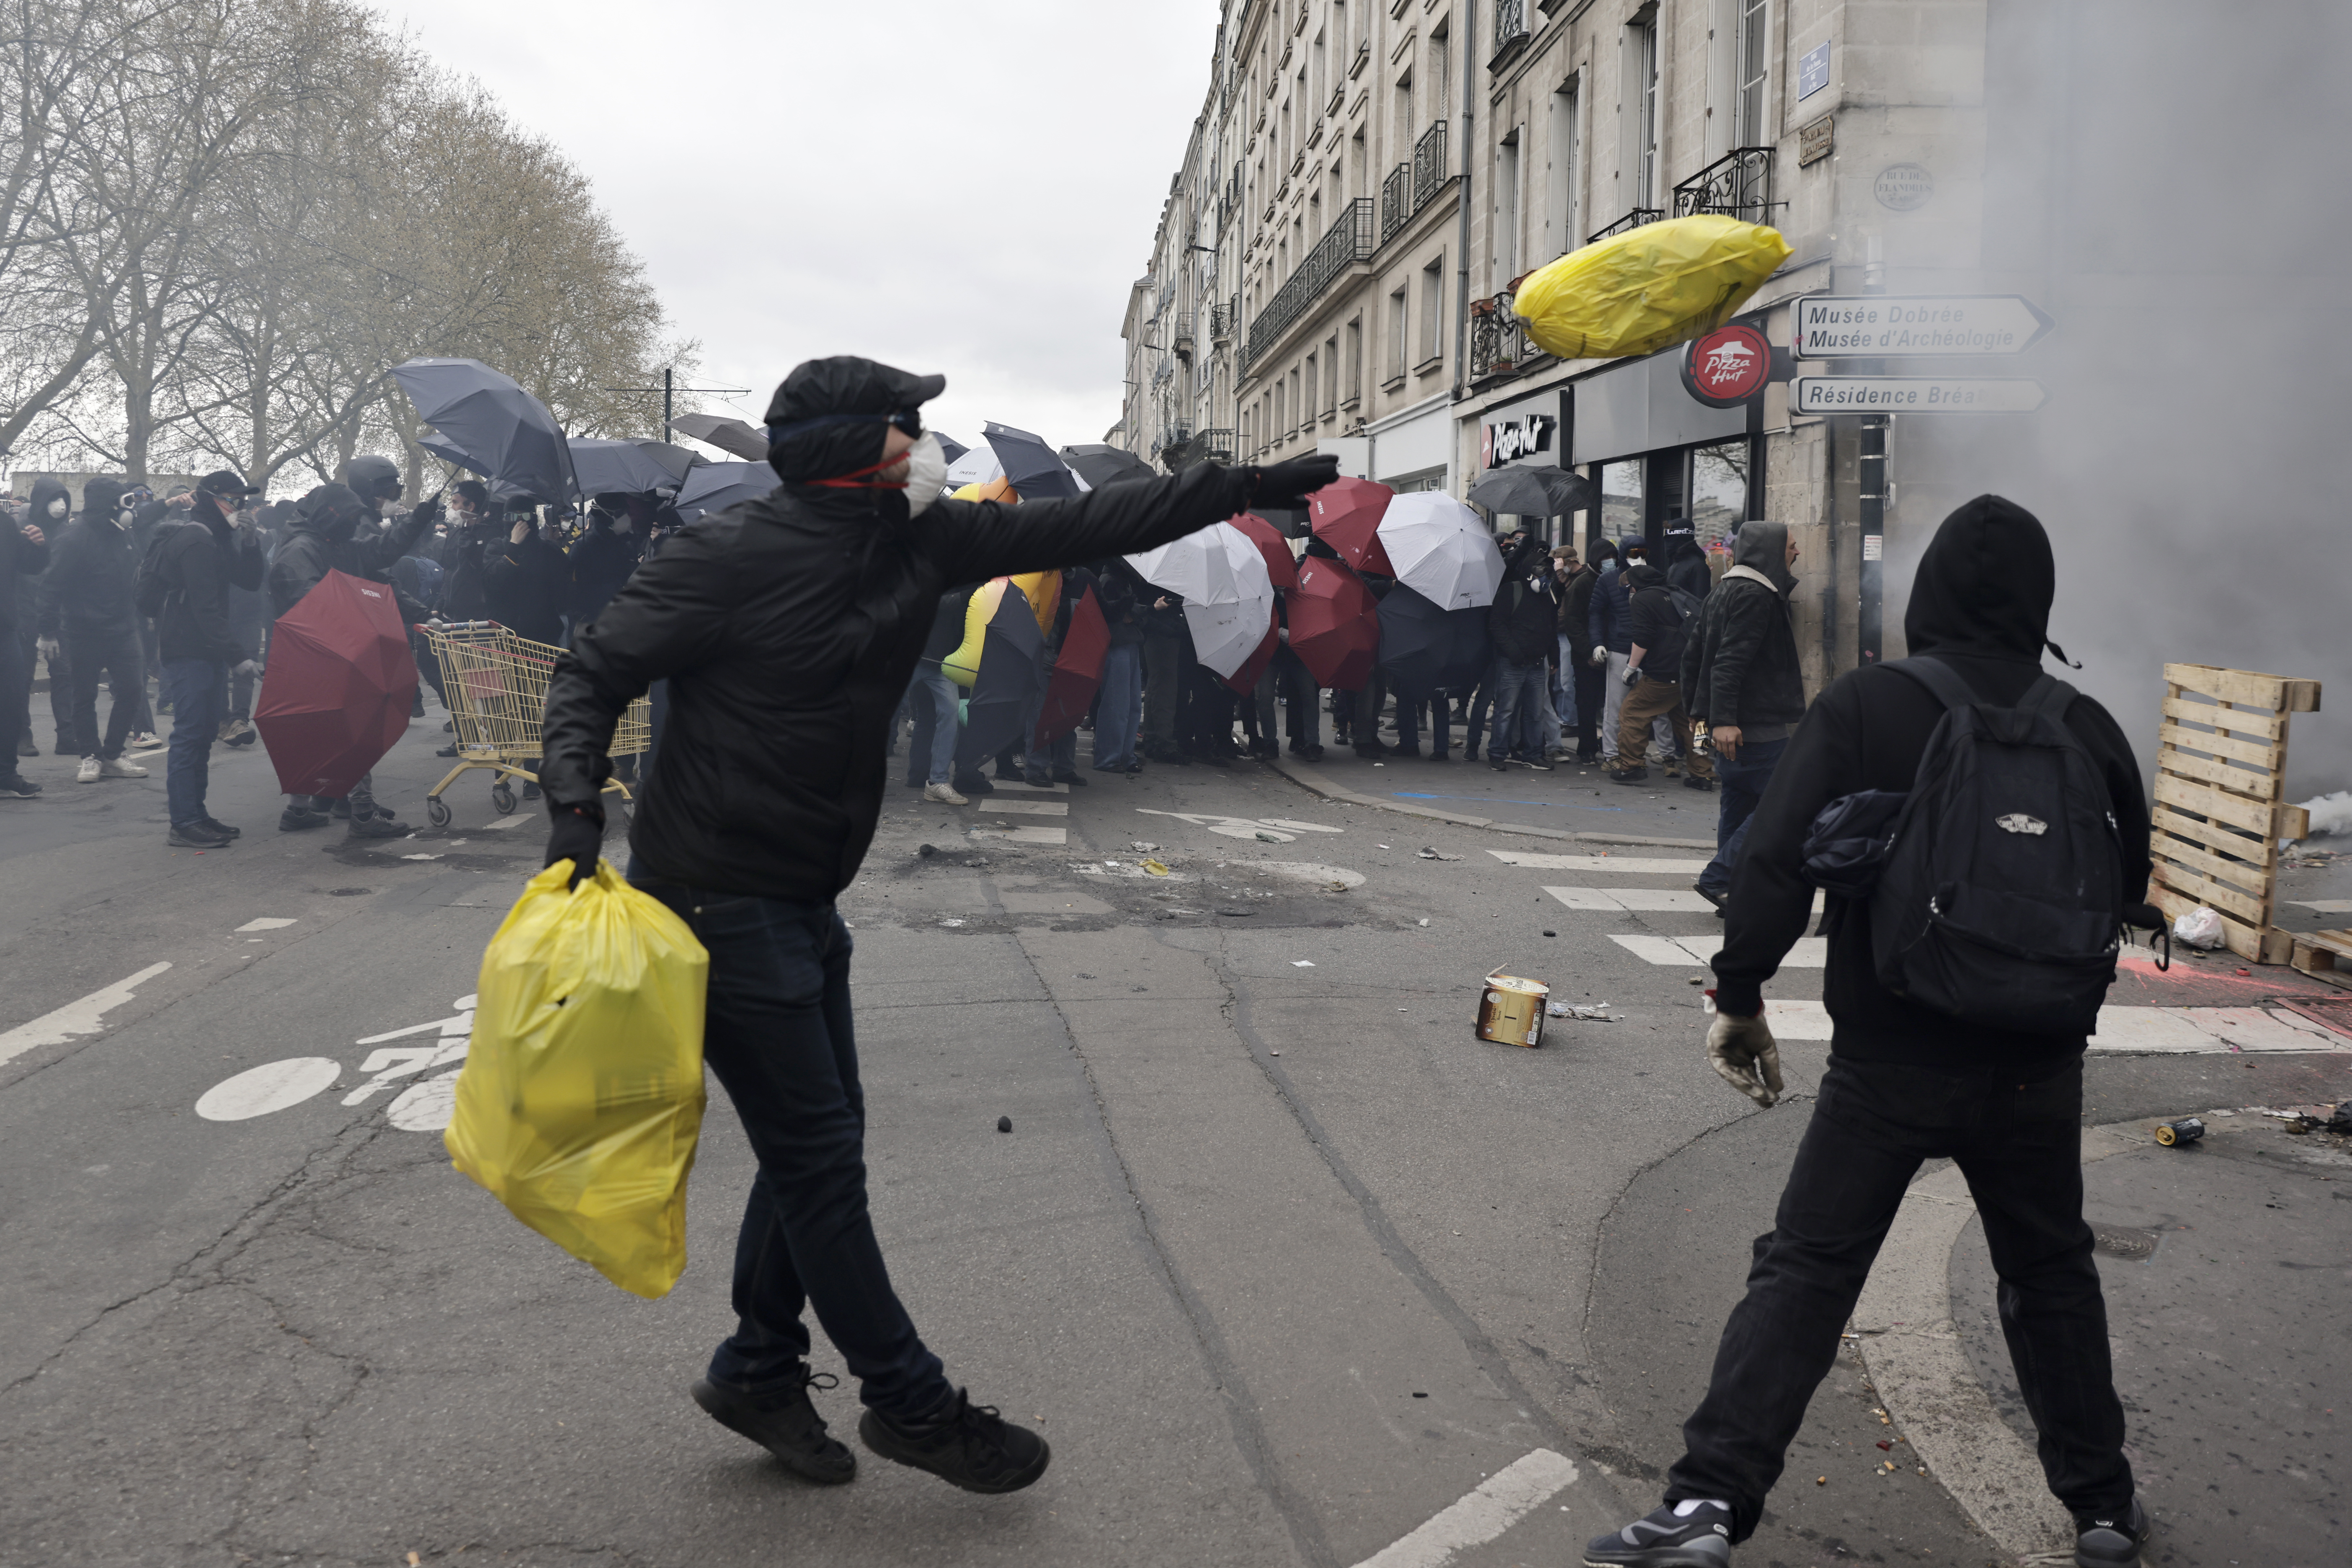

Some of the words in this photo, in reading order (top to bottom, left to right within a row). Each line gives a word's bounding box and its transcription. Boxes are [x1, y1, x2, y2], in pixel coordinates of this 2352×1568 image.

[1809, 307, 1878, 324] Musée
[1888, 305, 1964, 323] Dobrée
[1809, 330, 1872, 347] Musée
[1879, 329, 2013, 351] d'Archéologie
[1705, 356, 1751, 374] Pizza
[1711, 369, 1748, 385] Hut
[1810, 386, 1917, 404] Résidence
[1492, 421, 1520, 466] Pizza
[1519, 414, 1543, 456] Hut
[1302, 572, 1313, 584] INESIS
[361, 588, 381, 598] INESIS
